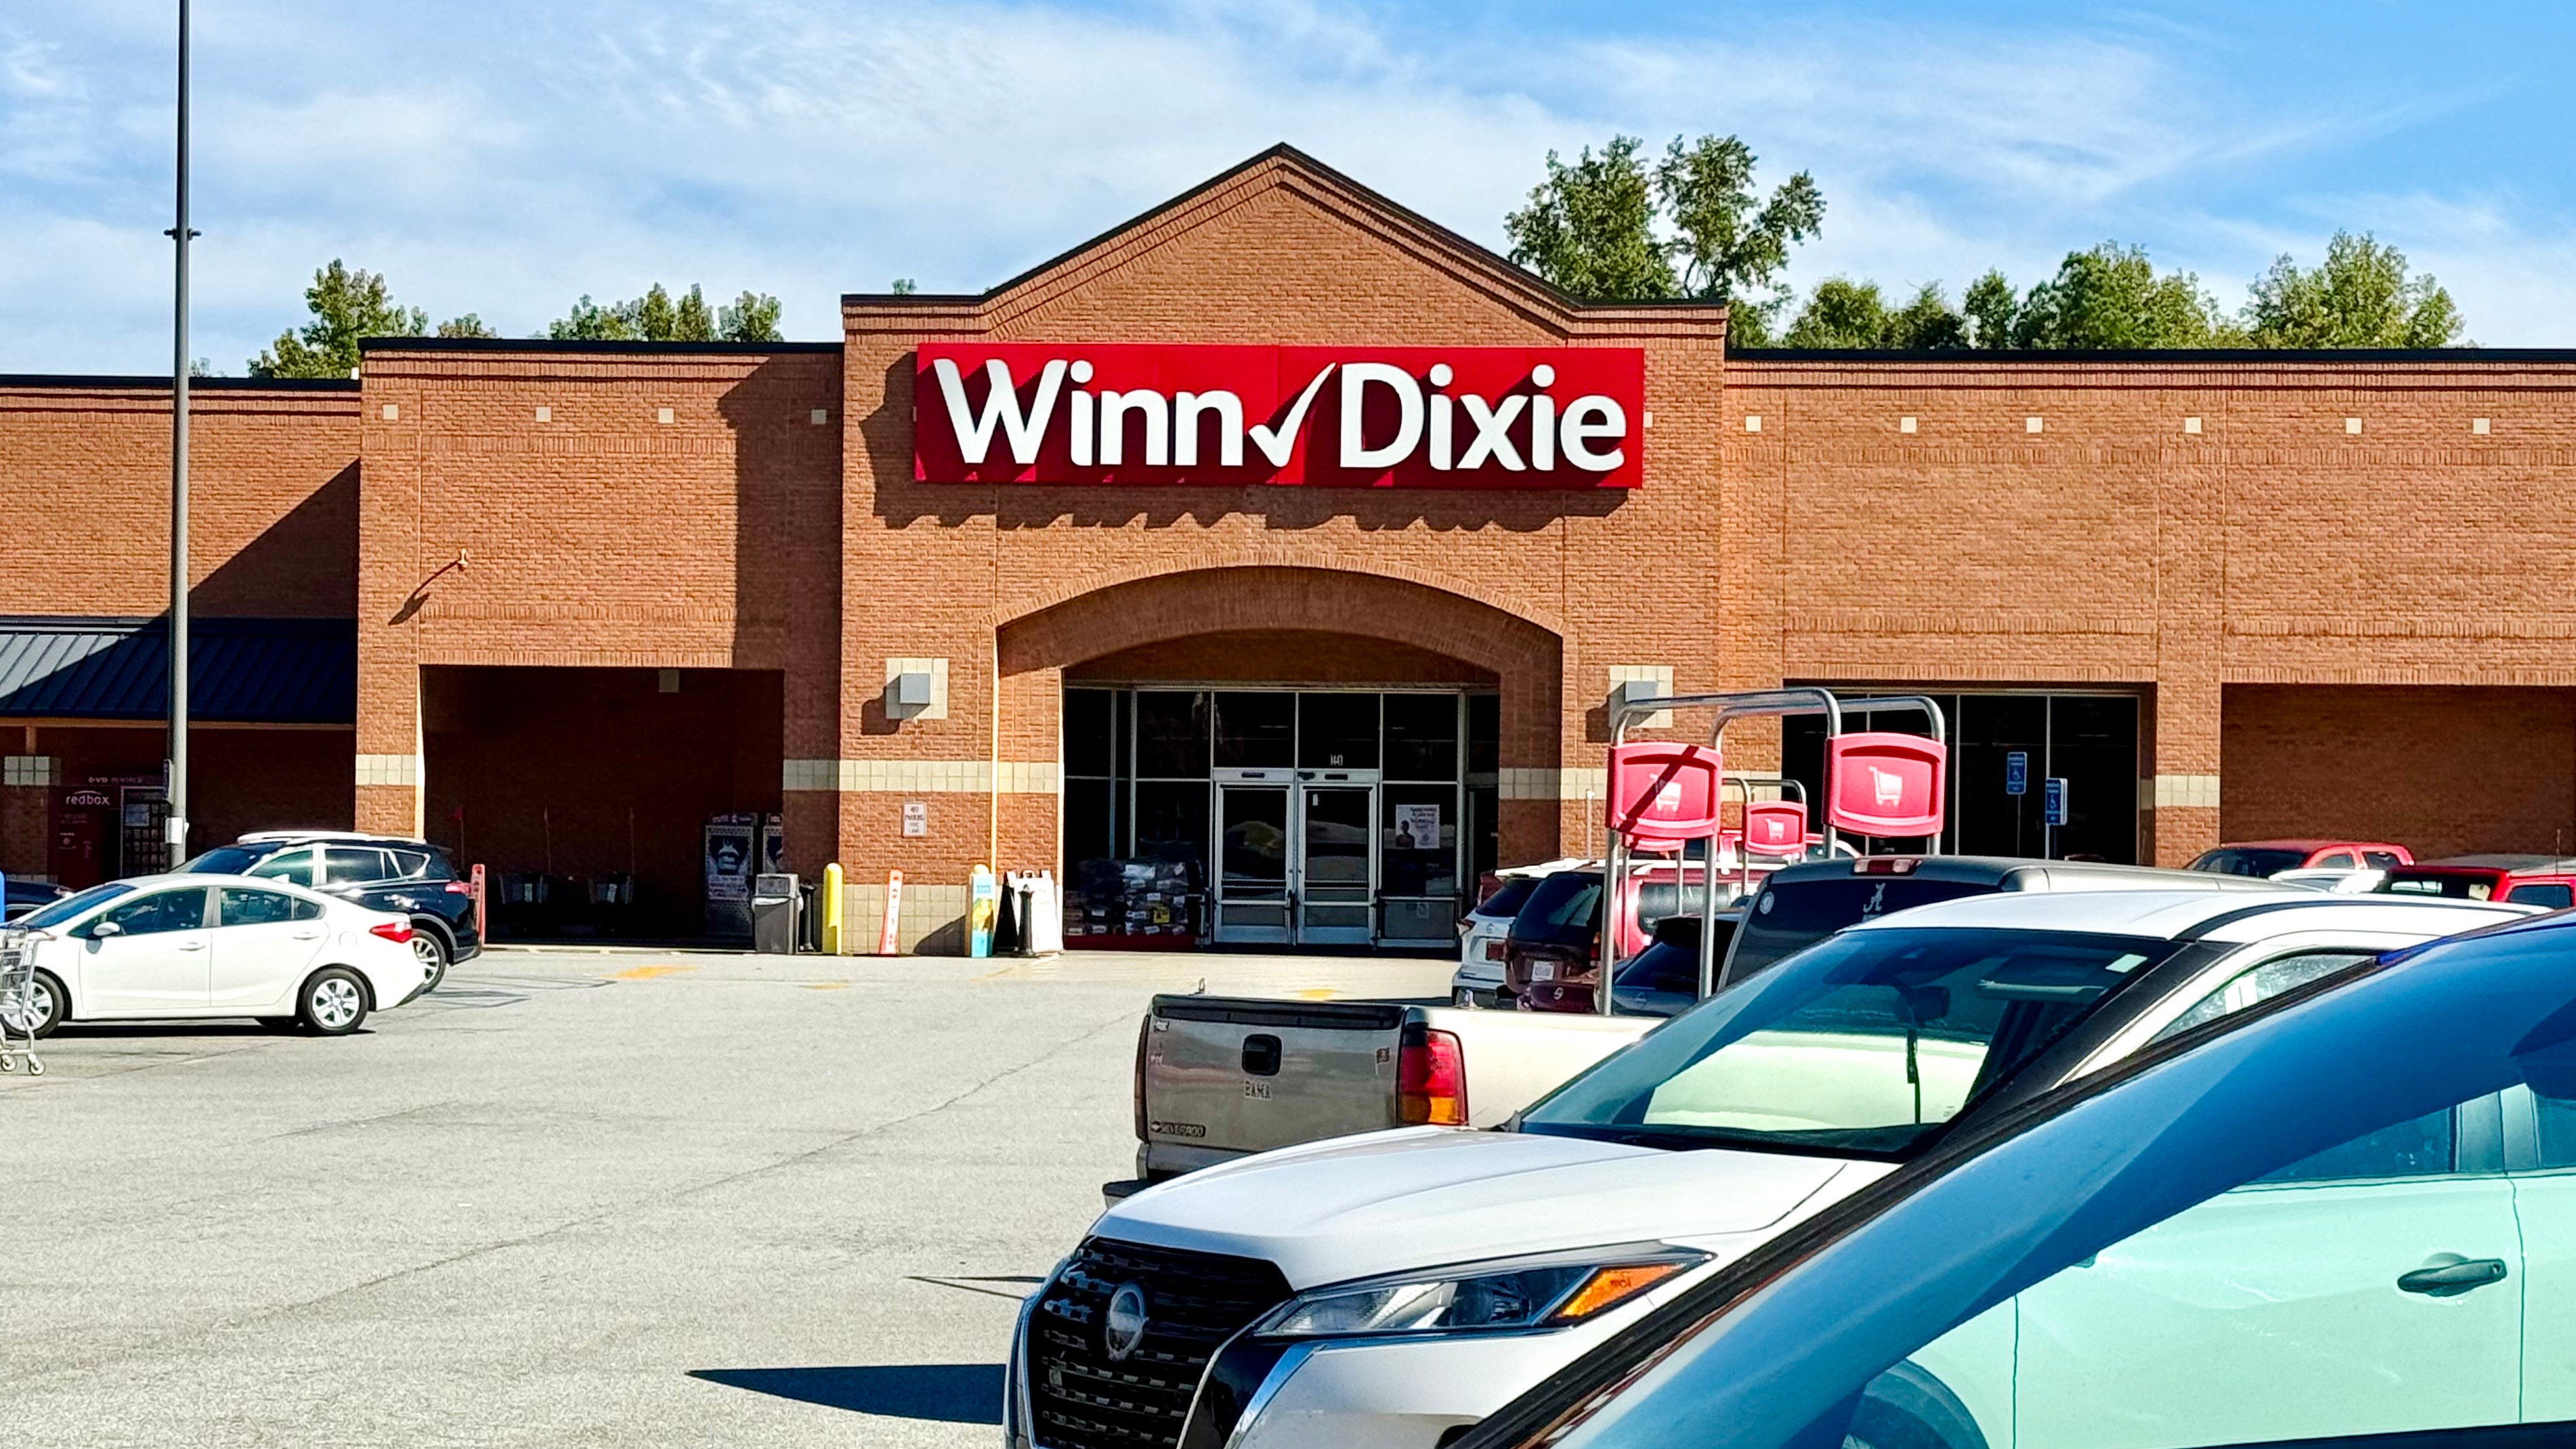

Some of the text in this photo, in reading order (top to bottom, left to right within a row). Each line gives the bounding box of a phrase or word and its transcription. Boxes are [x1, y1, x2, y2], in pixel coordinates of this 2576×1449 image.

[932, 358, 1627, 471] Winn Dixie
[66, 795, 110, 805] redbox
[1245, 1080, 1272, 1100] BAMA
